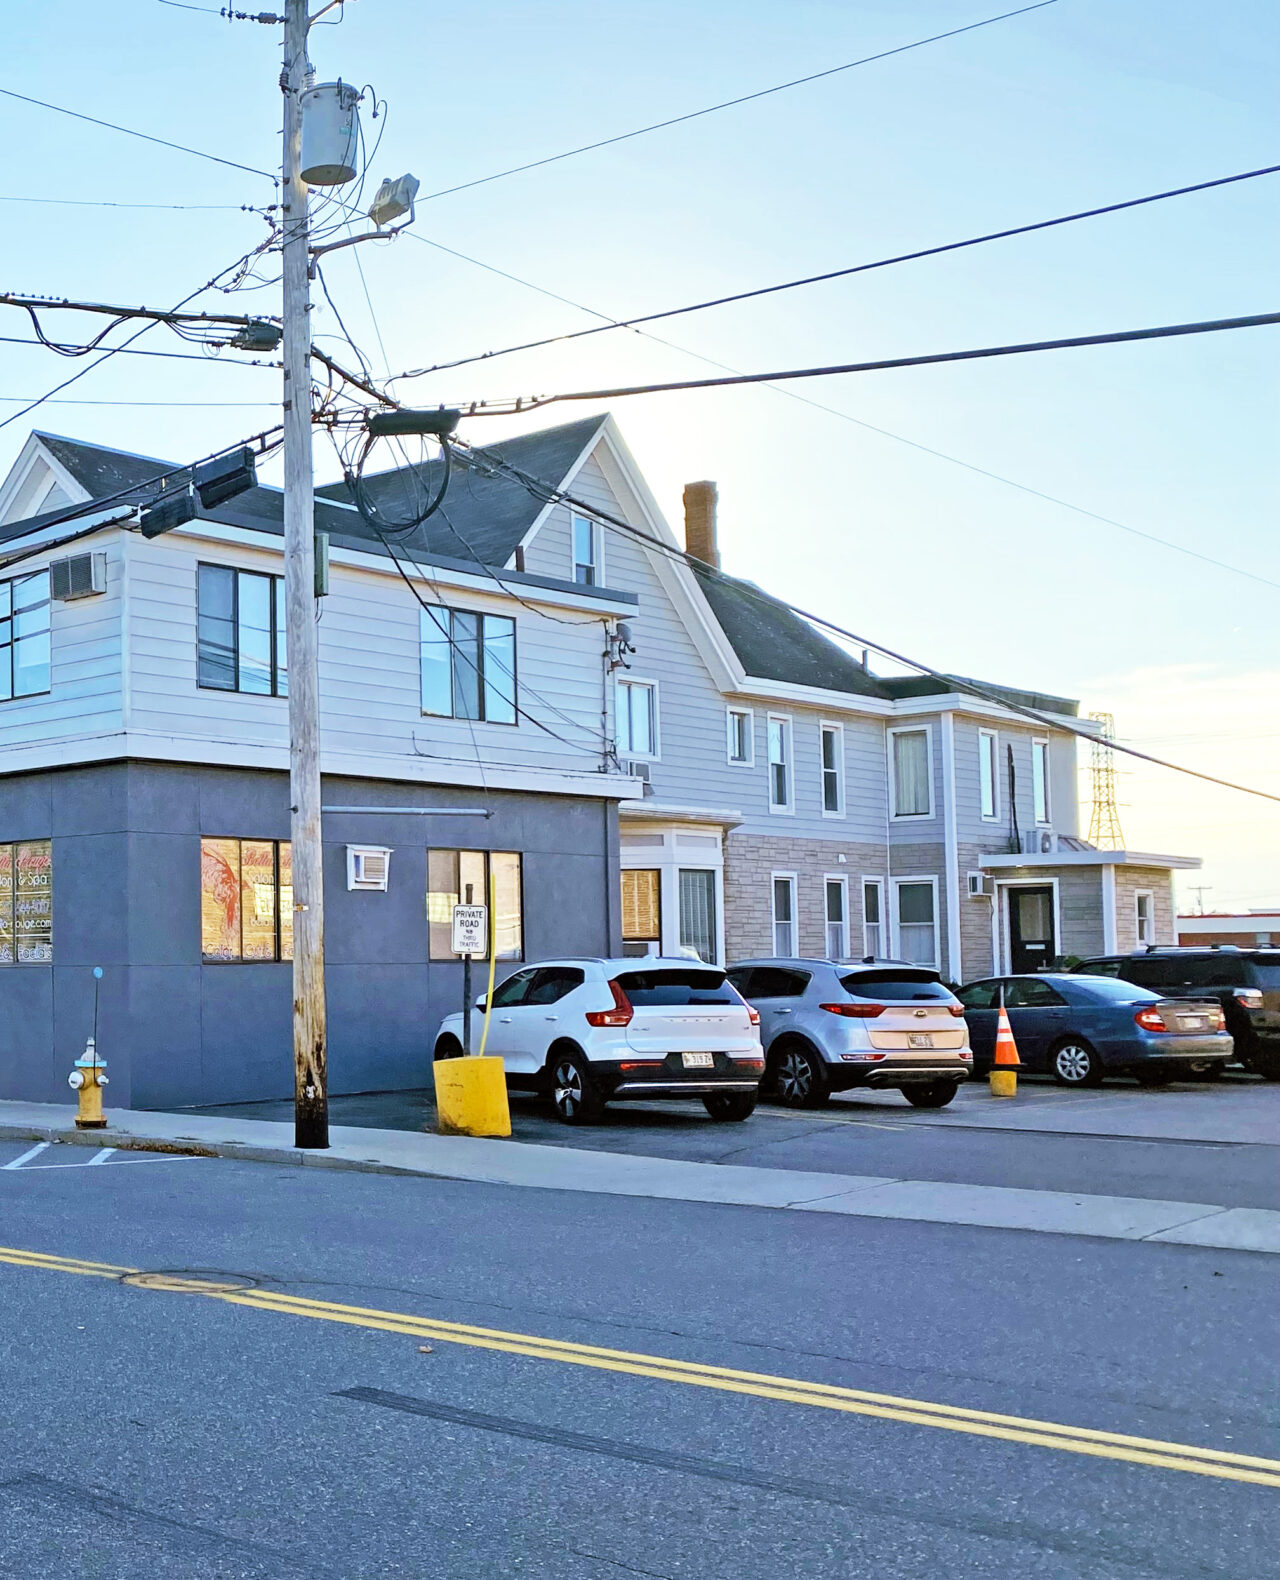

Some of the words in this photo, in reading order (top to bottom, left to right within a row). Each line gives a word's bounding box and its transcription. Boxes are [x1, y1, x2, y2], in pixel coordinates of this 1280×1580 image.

[18, 872, 26, 886] &
[28, 872, 49, 887] Spa
[456, 910, 483, 918] PRIVATE
